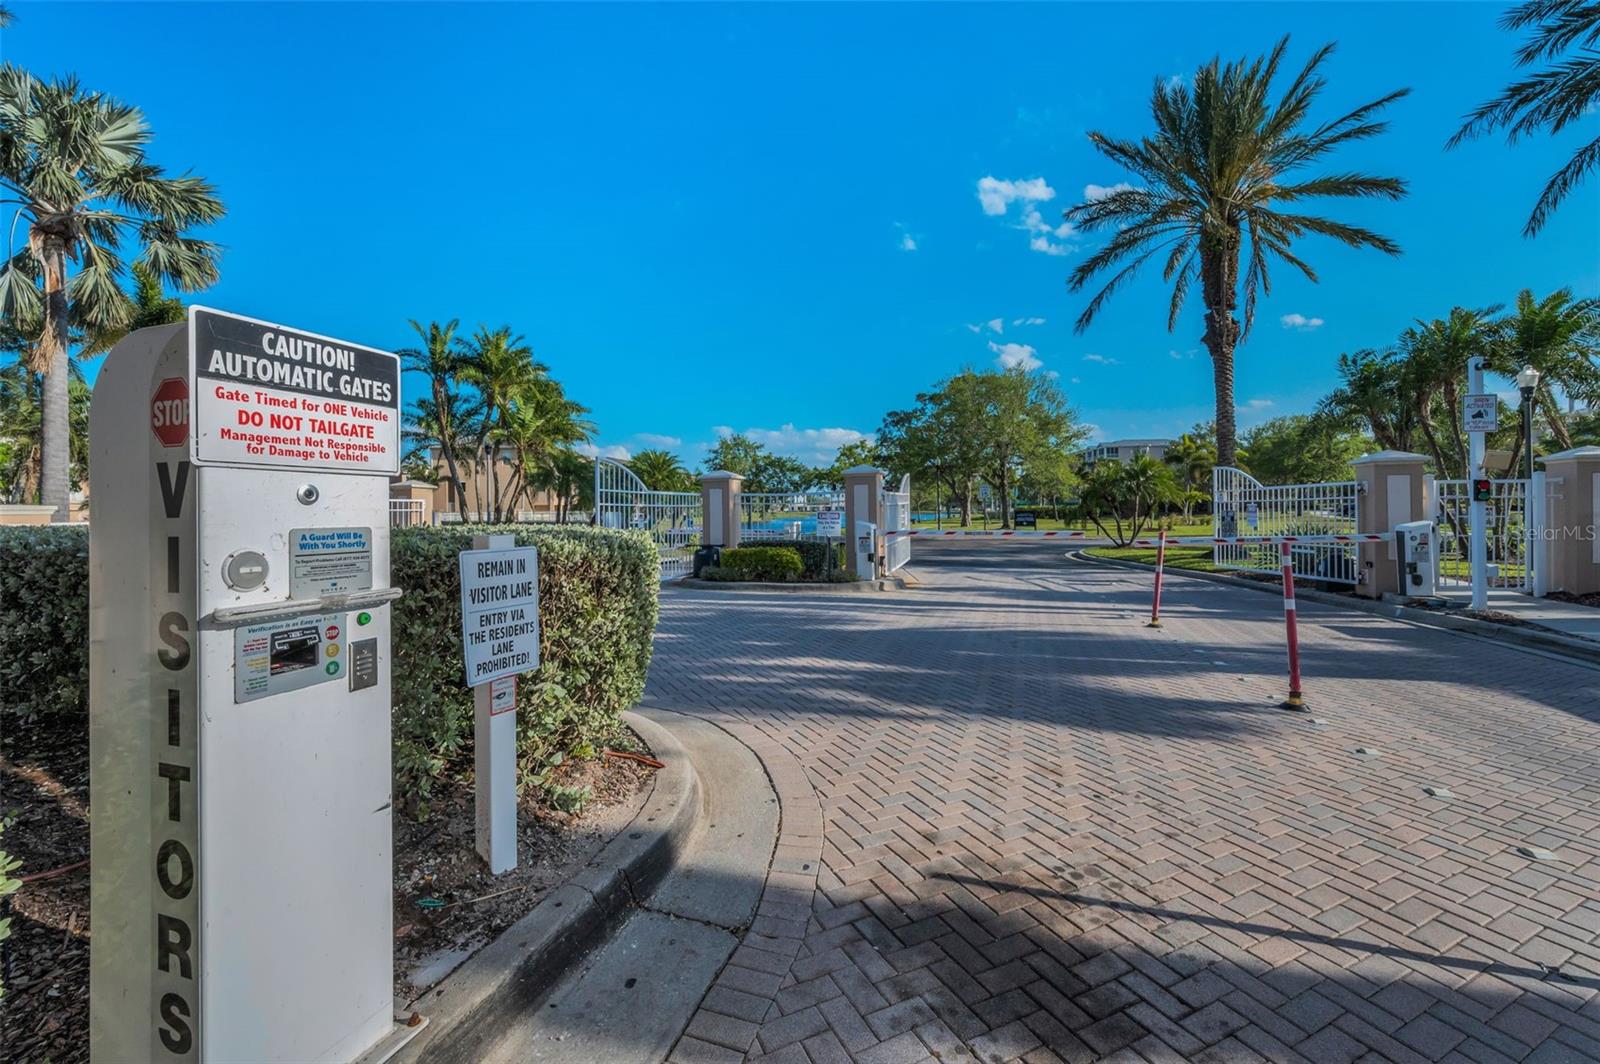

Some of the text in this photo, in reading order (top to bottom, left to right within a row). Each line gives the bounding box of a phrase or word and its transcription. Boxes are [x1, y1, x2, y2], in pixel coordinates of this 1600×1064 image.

[262, 332, 355, 372] CAUTION!
[208, 350, 392, 402] AUTOMATIC GATES
[215, 386, 389, 422] Gate Timed for ONE Vehicle
[238, 409, 375, 439] DO NOT TAILGATE
[220, 428, 386, 454] Management Not Responsible
[246, 443, 369, 463] for Damage to Vehicle
[299, 540, 366, 550] With You Shortly
[300, 533, 308, 541] A
[309, 532, 335, 541] Guard
[336, 532, 352, 540] Will
[478, 558, 526, 578] REMAIN IN
[470, 582, 532, 604] VISITOR LANE
[248, 624, 284, 634] Verification
[300, 619, 314, 627] Easy
[480, 609, 525, 627] ENTRY VIA
[469, 621, 535, 646] THE RESIDENTS
[492, 641, 514, 656] LANE
[476, 652, 530, 677] PROHIBITED!
[156, 461, 194, 1055] VISITORS
